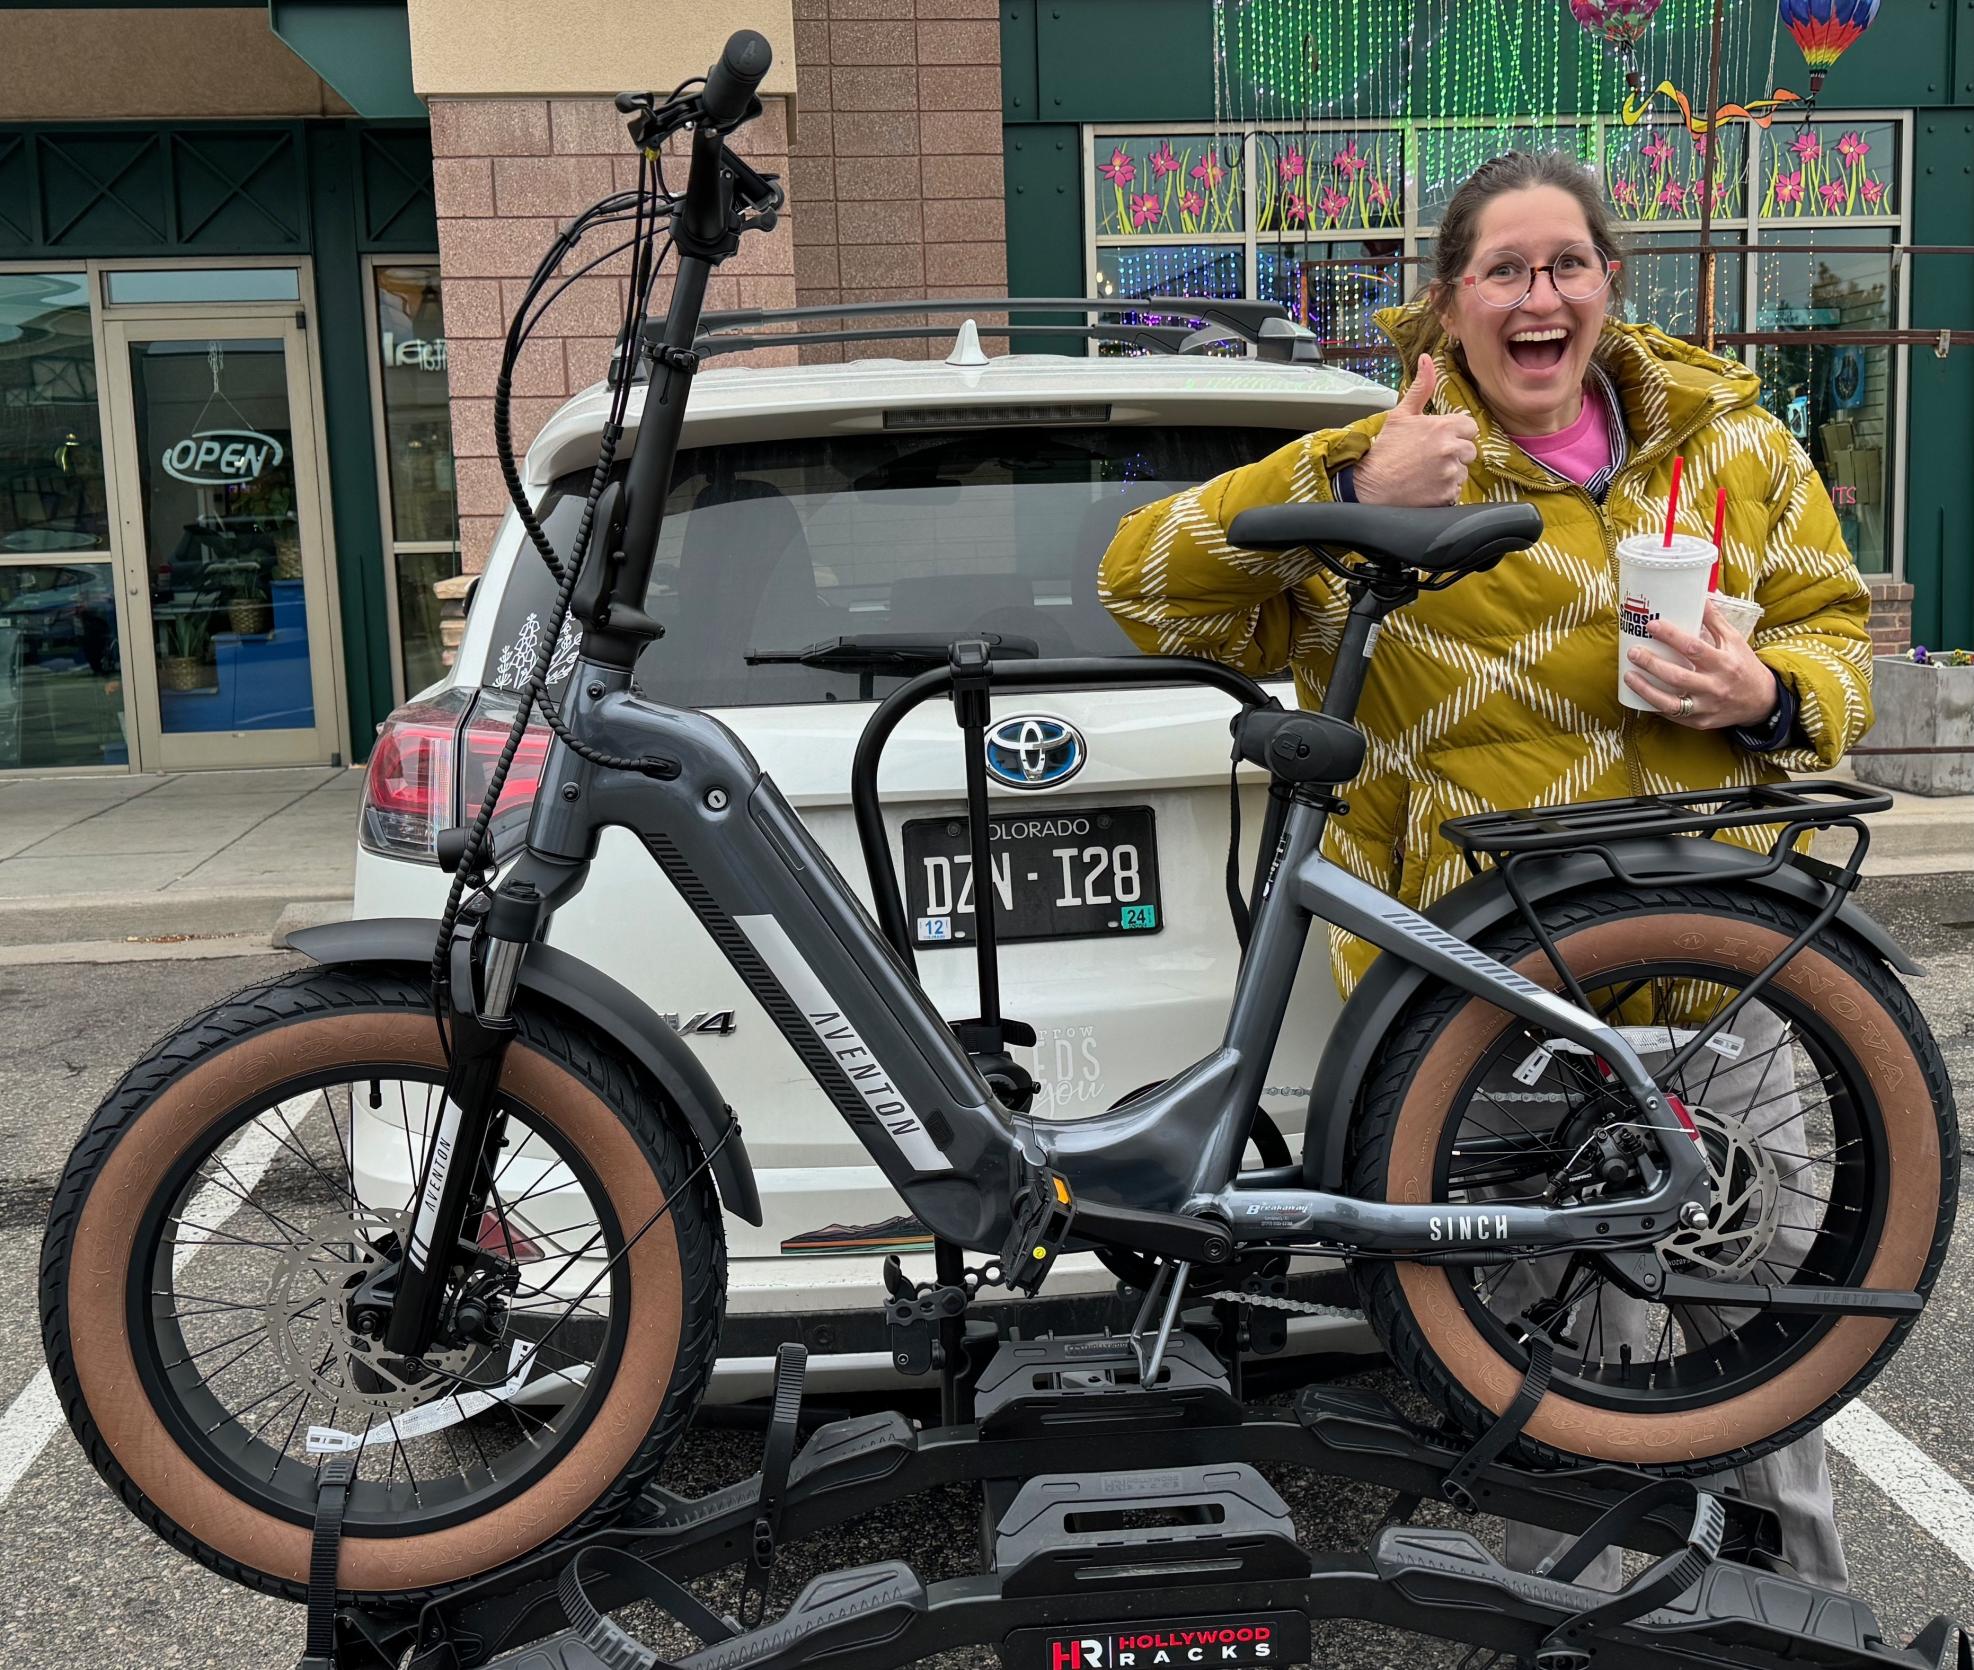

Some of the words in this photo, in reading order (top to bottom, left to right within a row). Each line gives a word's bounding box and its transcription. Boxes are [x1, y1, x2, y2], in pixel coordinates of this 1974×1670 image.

[171, 440, 268, 477] OPEN
[1620, 618, 1654, 639] BURGE
[990, 818, 1089, 840] OLORADO
[925, 920, 944, 935] 12
[1127, 909, 1146, 924] 24
[658, 1010, 737, 1037] V4
[1038, 1026, 1093, 1041] rrow
[1012, 1037, 1101, 1083] EDS
[809, 1012, 921, 1136] AVENTON
[424, 1136, 451, 1213] AVENTON
[1429, 1214, 1509, 1242] SINCH
[1052, 1639, 1104, 1670] HR
[1119, 1627, 1271, 1649] HOLLYWOOD
[1119, 1643, 1271, 1667] RACKS
